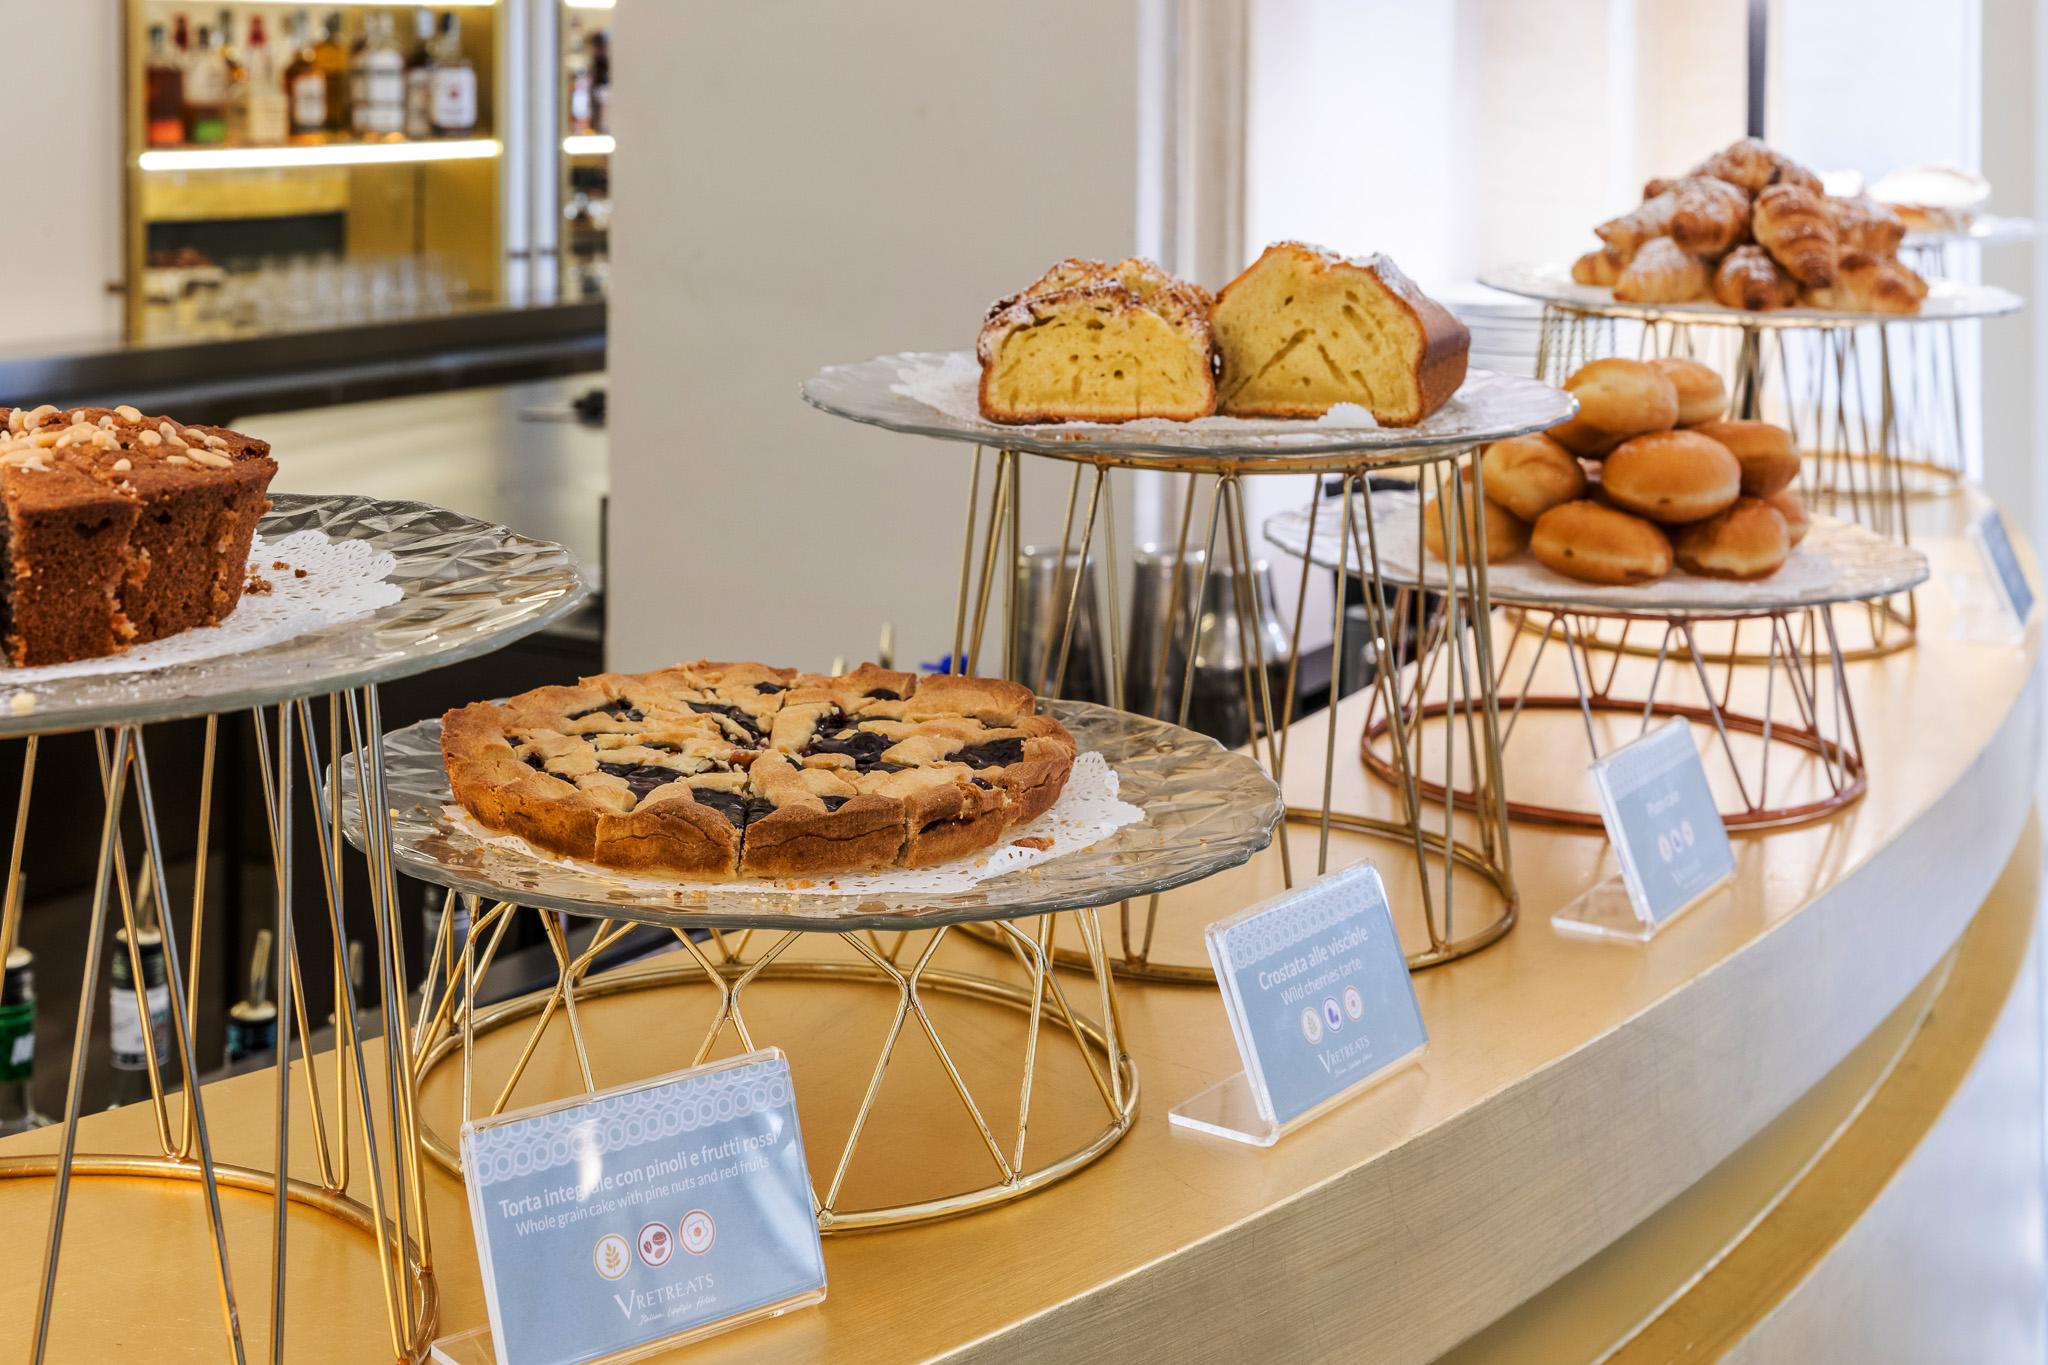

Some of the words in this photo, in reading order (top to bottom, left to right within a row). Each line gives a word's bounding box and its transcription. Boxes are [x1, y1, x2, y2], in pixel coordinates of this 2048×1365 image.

[1259, 957, 1308, 991] Crostata
[1308, 945, 1329, 967] alle
[1327, 926, 1369, 957] visciole
[1280, 984, 1304, 1006] Wild
[1340, 958, 1363, 977] tarte
[498, 1195, 542, 1218] Torta
[544, 1174, 613, 1207] integale
[616, 1167, 643, 1187] con
[646, 1151, 687, 1182] pinoli
[690, 1152, 699, 1167] e
[701, 1136, 740, 1164] frutti
[515, 1215, 556, 1237] Whole
[558, 1205, 588, 1229] grain
[589, 1199, 615, 1216] cake
[617, 1190, 643, 1209] with
[645, 1184, 670, 1204] pine
[671, 1176, 696, 1193] nuts
[697, 1168, 718, 1186] and
[719, 1162, 738, 1180] red
[740, 1155, 770, 1174] fruits
